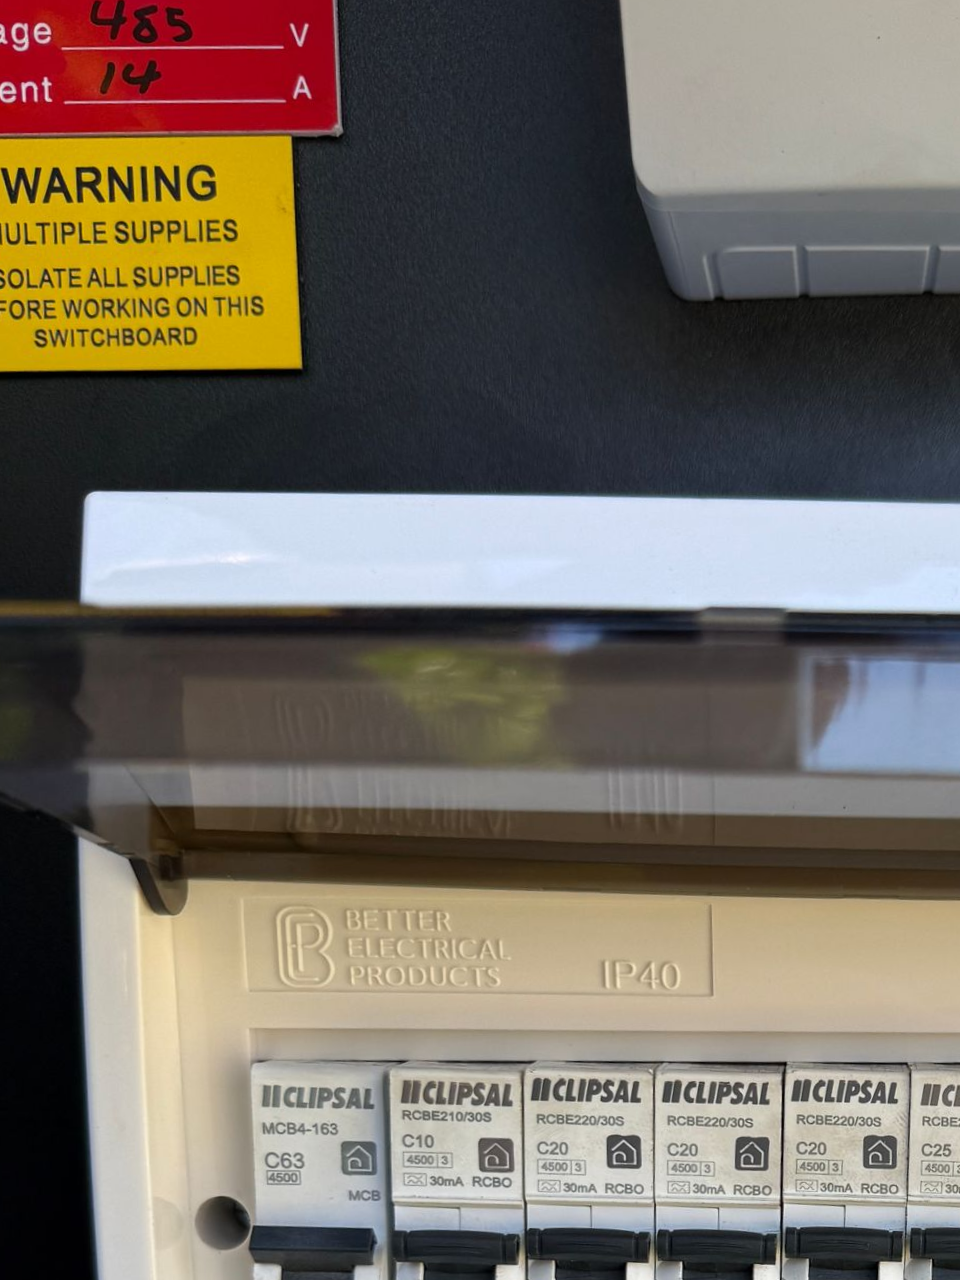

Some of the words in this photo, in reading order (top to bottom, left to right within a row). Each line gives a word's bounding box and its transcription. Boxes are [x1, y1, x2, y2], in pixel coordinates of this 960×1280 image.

[90, 0, 194, 43] 485
[289, 22, 310, 48] V
[100, 60, 162, 95] 14
[0, 76, 53, 104] ent
[292, 75, 312, 101] A
[1, 165, 217, 205] WARNING
[0, 221, 108, 246] ULTIPLE
[114, 219, 239, 245] SUPPLIES
[87, 267, 128, 289] ALL
[132, 264, 241, 288] SUPPLIES
[64, 297, 171, 320] WORKING
[176, 296, 208, 318] ON
[214, 295, 265, 317] THIS
[33, 326, 198, 348] SWITCHBOARD
[344, 908, 453, 932] BETTER
[347, 938, 512, 962] ELECTRICAL
[349, 965, 502, 988] PRODUCTS
[599, 958, 682, 991] IP40
[283, 1085, 375, 1110] CLIPSAL
[423, 1081, 513, 1107] CLIPSAL
[552, 1078, 641, 1103] CLIPSAL
[683, 1081, 770, 1105] CLIPSAL
[812, 1079, 899, 1104] CLIPSAL
[402, 1110, 492, 1123] RCBE210/30S
[536, 1114, 624, 1126] RCBE220/30S
[666, 1116, 754, 1128] RCBE220/30S
[796, 1114, 882, 1127] RCBE220/30S
[262, 1122, 339, 1137] MCB4-163
[402, 1134, 435, 1149] C10
[536, 1142, 569, 1156] C20
[796, 1142, 827, 1156] C20
[667, 1143, 699, 1157] C20
[921, 1143, 952, 1157] C25
[264, 1152, 305, 1170] C63
[406, 1154, 435, 1166] 4500
[440, 1154, 449, 1165] 3
[541, 1161, 568, 1173] 4500
[574, 1161, 583, 1173] 3
[670, 1161, 698, 1174] 4500
[703, 1162, 712, 1173] 3
[799, 1161, 826, 1172] 4500
[832, 1161, 839, 1172] 3
[924, 1162, 951, 1174] 4500
[268, 1171, 299, 1184] 4500
[429, 1177, 464, 1188] 30mA
[472, 1177, 513, 1189] RCBO
[348, 1190, 381, 1202] MCB
[563, 1183, 597, 1194] 30mA
[604, 1183, 644, 1195] RCBO
[692, 1184, 726, 1195] 30mA
[733, 1185, 772, 1196] RCBO
[819, 1182, 853, 1193] 30mA
[860, 1183, 899, 1195] RCBO
